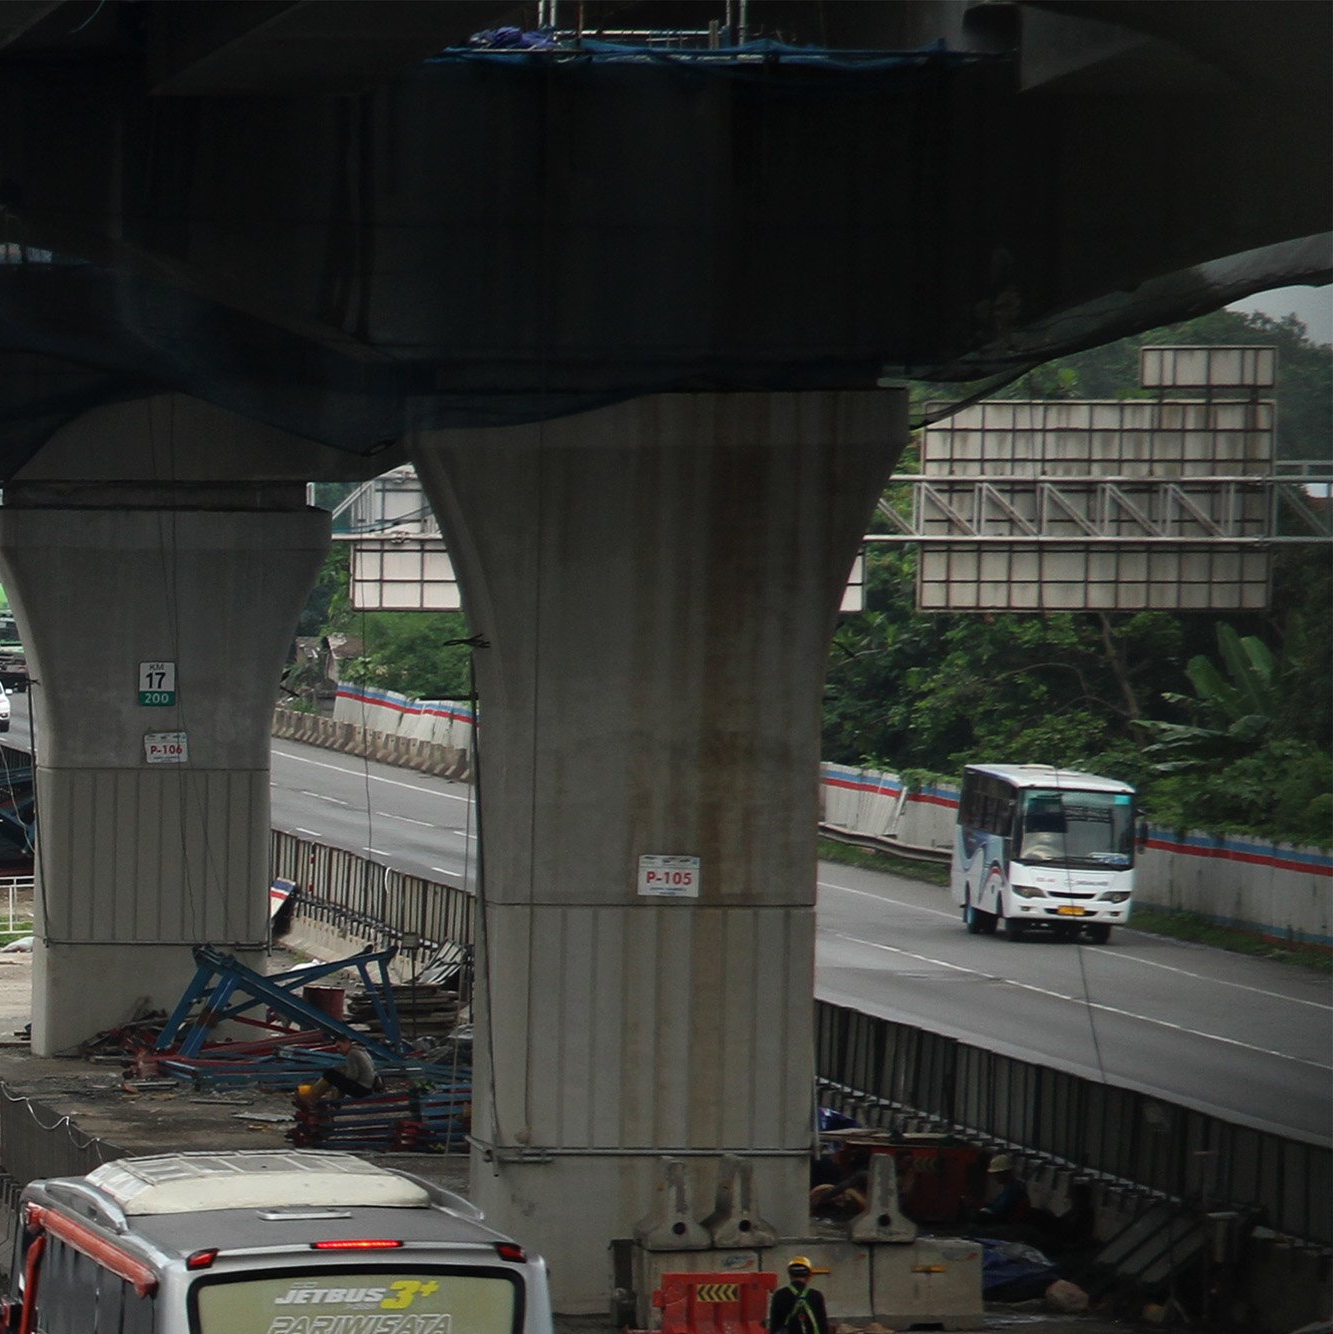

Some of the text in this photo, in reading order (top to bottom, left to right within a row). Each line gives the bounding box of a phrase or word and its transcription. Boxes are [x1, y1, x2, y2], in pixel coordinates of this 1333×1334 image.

[146, 672, 165, 689] 17
[145, 693, 169, 703] 200
[150, 745, 183, 754] P-106
[646, 871, 693, 885] P-105
[274, 1288, 387, 1305] JETBUS
